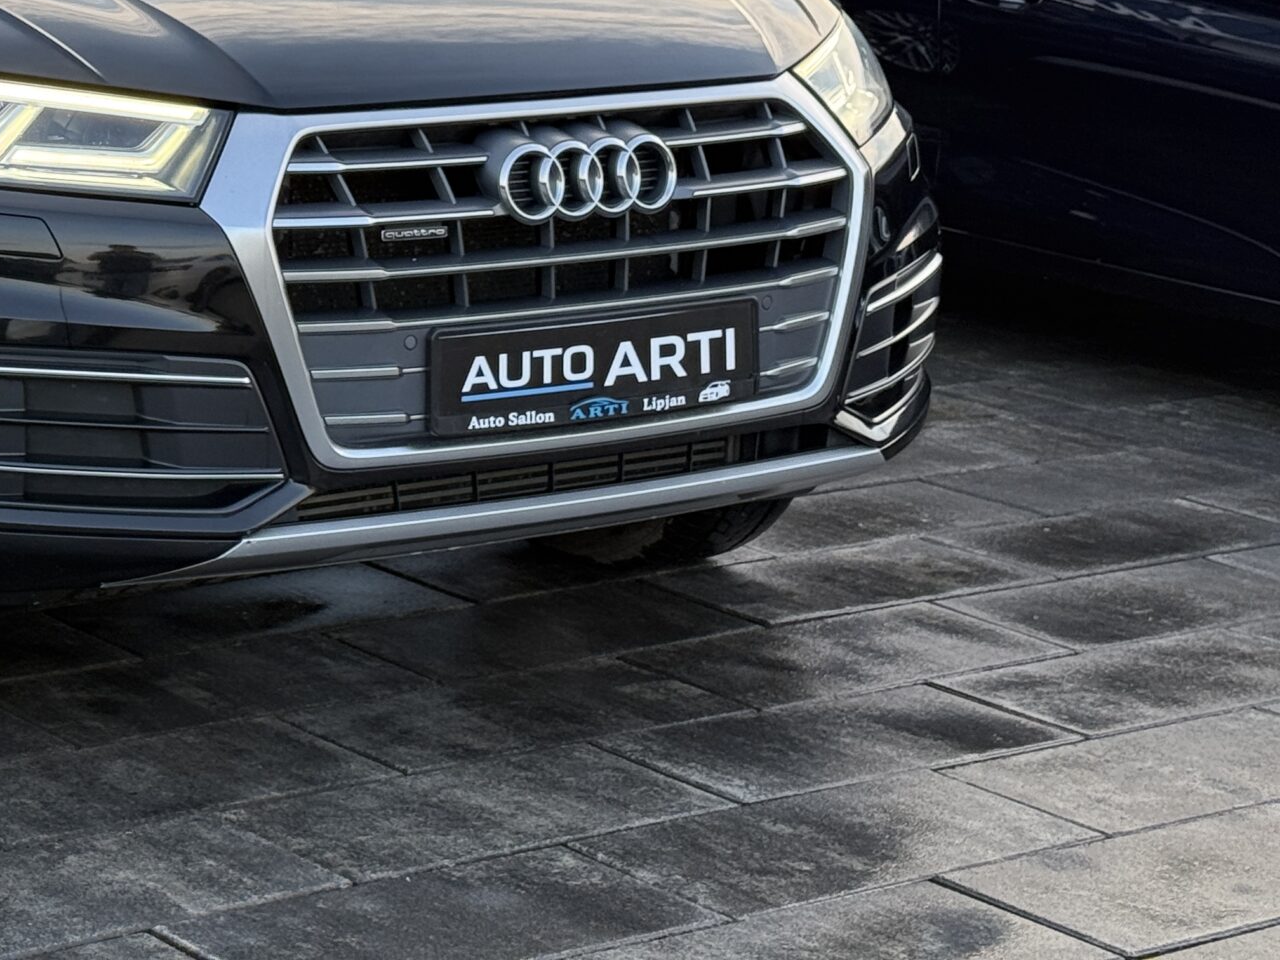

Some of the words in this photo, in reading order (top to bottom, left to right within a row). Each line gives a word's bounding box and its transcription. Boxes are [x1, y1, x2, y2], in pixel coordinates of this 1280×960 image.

[385, 228, 446, 240] quattro
[461, 344, 595, 393] AUTO
[604, 327, 736, 387] ARTI
[468, 414, 505, 430] Auto
[508, 409, 555, 426] Sallon
[570, 400, 630, 420] ARTI
[642, 394, 687, 412] Lipjan
